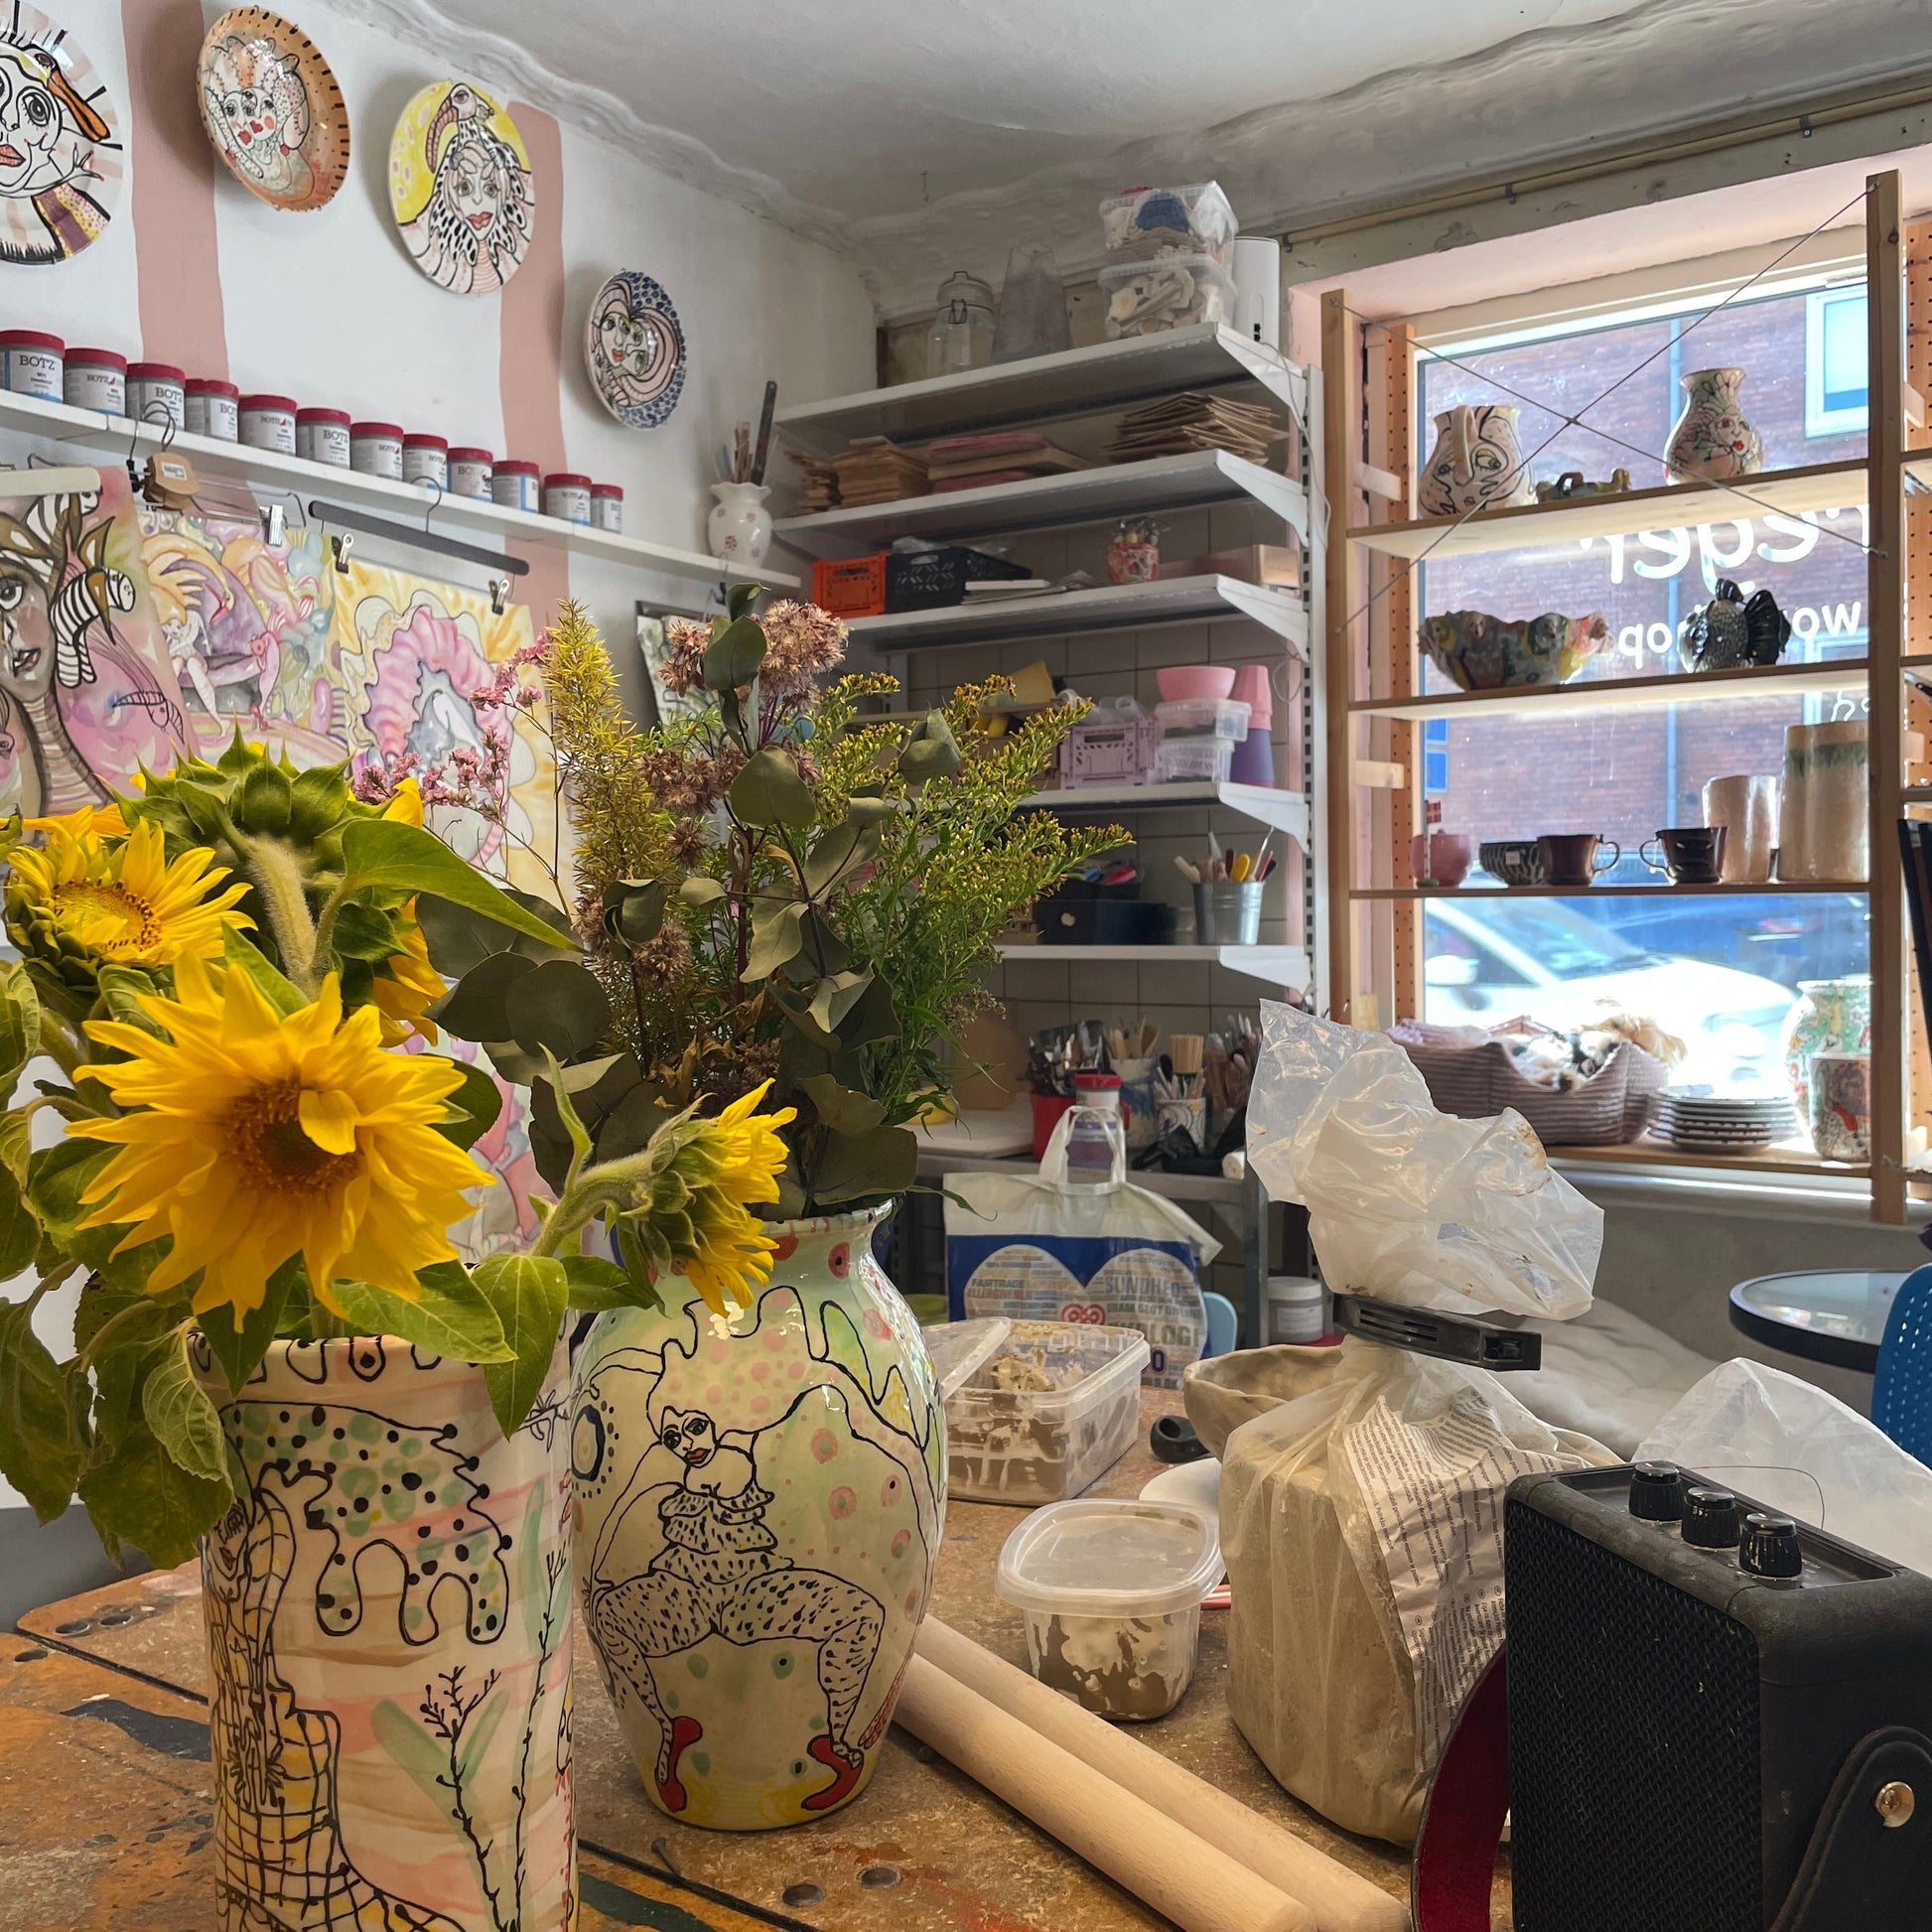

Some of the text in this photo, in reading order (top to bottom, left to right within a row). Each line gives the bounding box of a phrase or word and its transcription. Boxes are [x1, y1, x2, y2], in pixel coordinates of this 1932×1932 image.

[19, 354, 56, 371] BOTZ
[86, 373, 109, 383] BOTZ
[155, 386, 183, 403] BOTZ
[323, 429, 348, 444] BOTZ
[1104, 1276, 1181, 1298] SUNDHED
